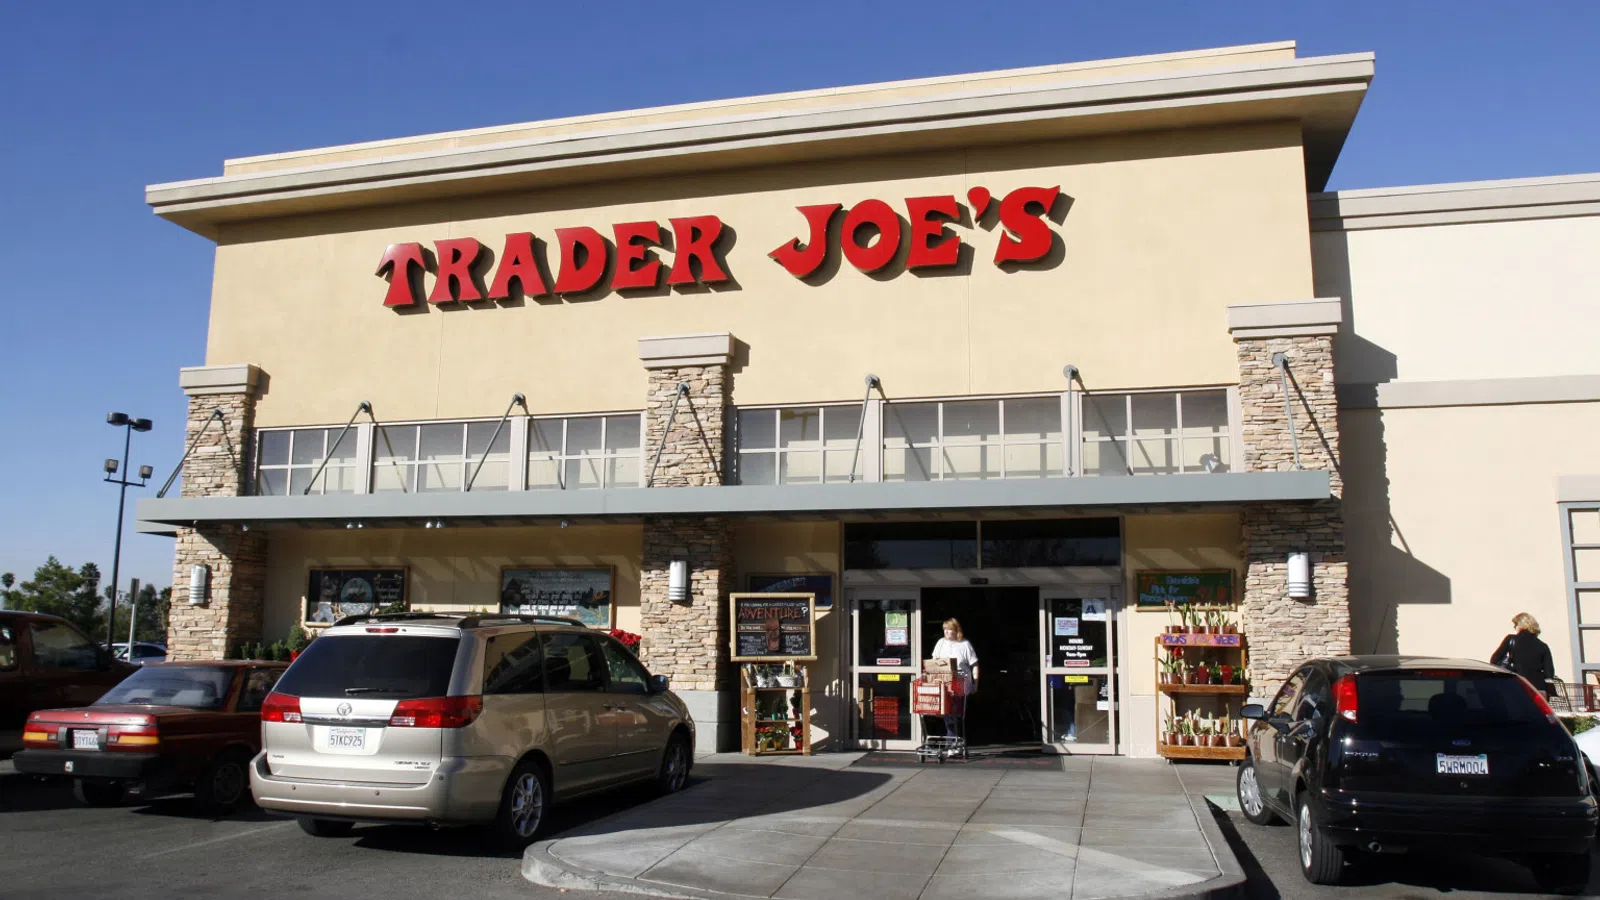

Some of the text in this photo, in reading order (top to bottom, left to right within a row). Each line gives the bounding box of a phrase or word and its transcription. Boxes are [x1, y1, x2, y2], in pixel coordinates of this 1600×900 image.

[375, 184, 1061, 308] TRADER JOE'S
[1085, 604, 1097, 614] A
[330, 734, 363, 747] 5TKC925
[1439, 760, 1486, 774] 5WRM004
